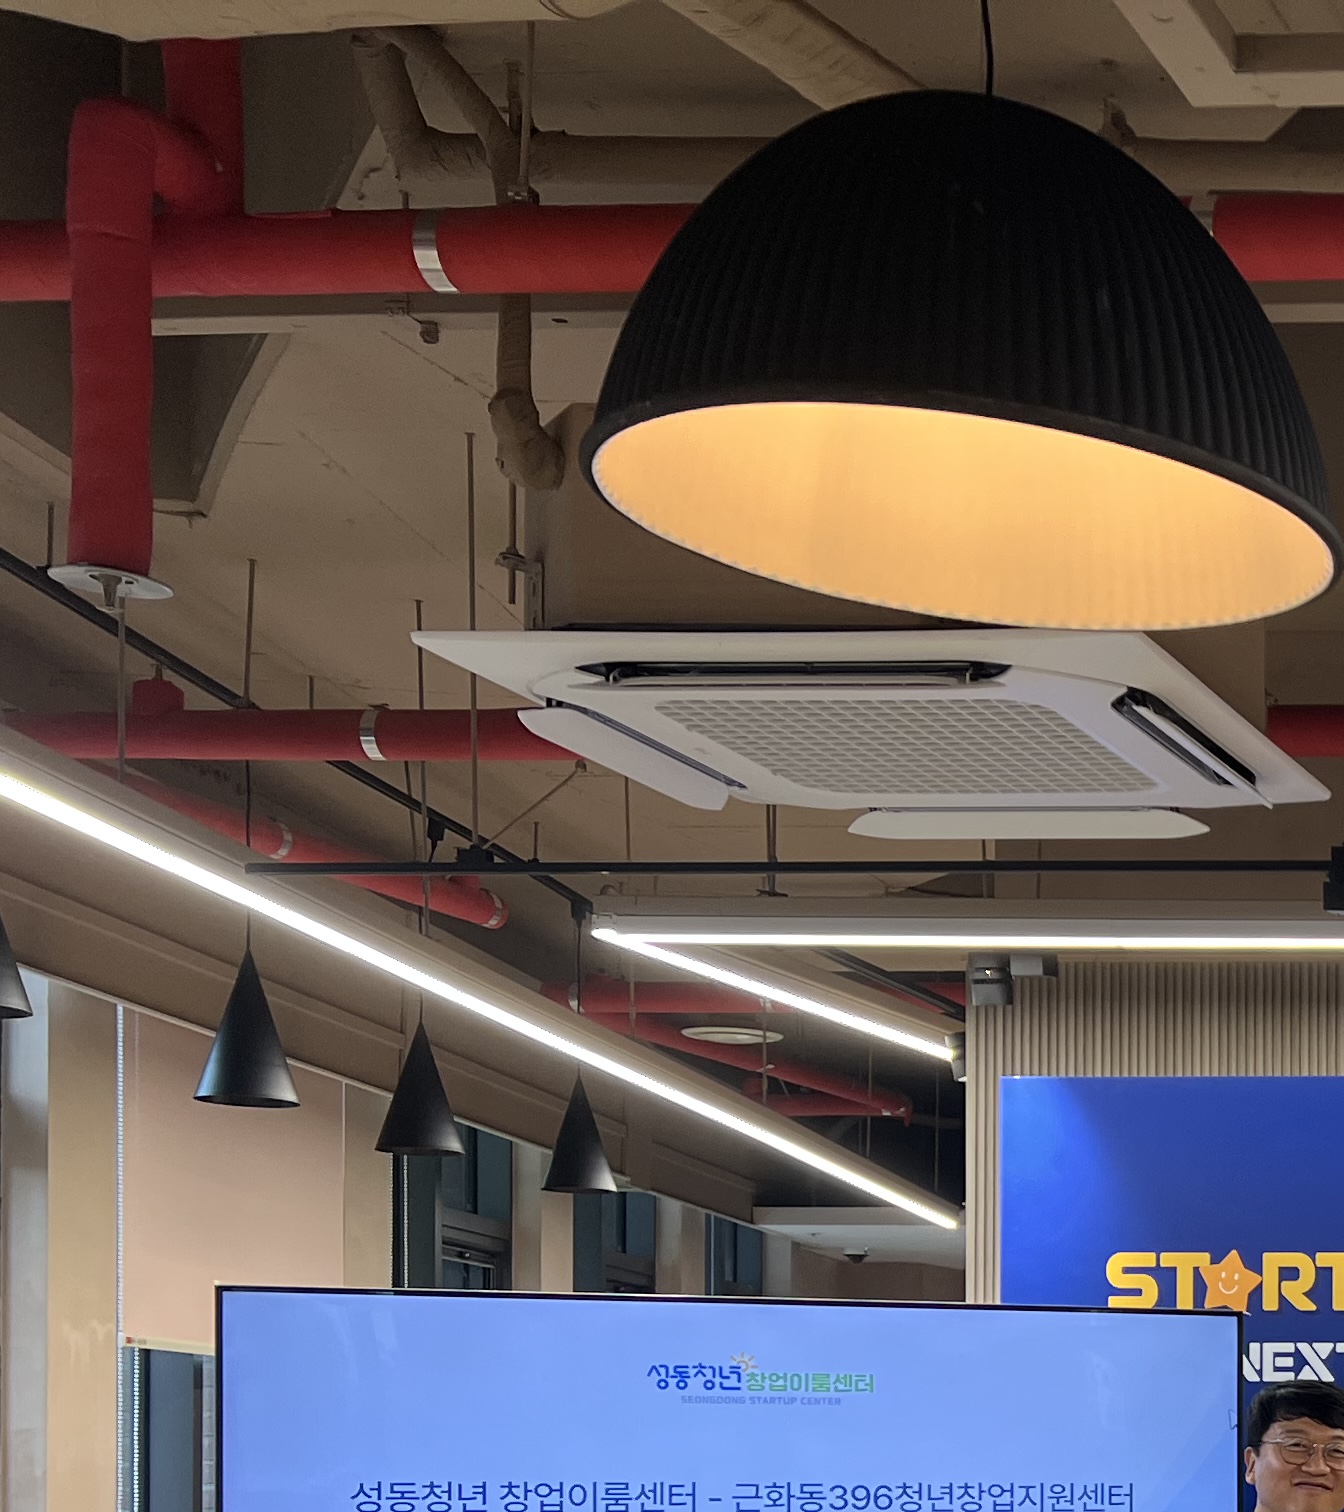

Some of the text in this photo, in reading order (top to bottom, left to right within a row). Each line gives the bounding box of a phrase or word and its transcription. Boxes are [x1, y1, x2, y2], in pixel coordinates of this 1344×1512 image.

[681, 1395, 842, 1406] SEONGDONG STARTUP CENTER
